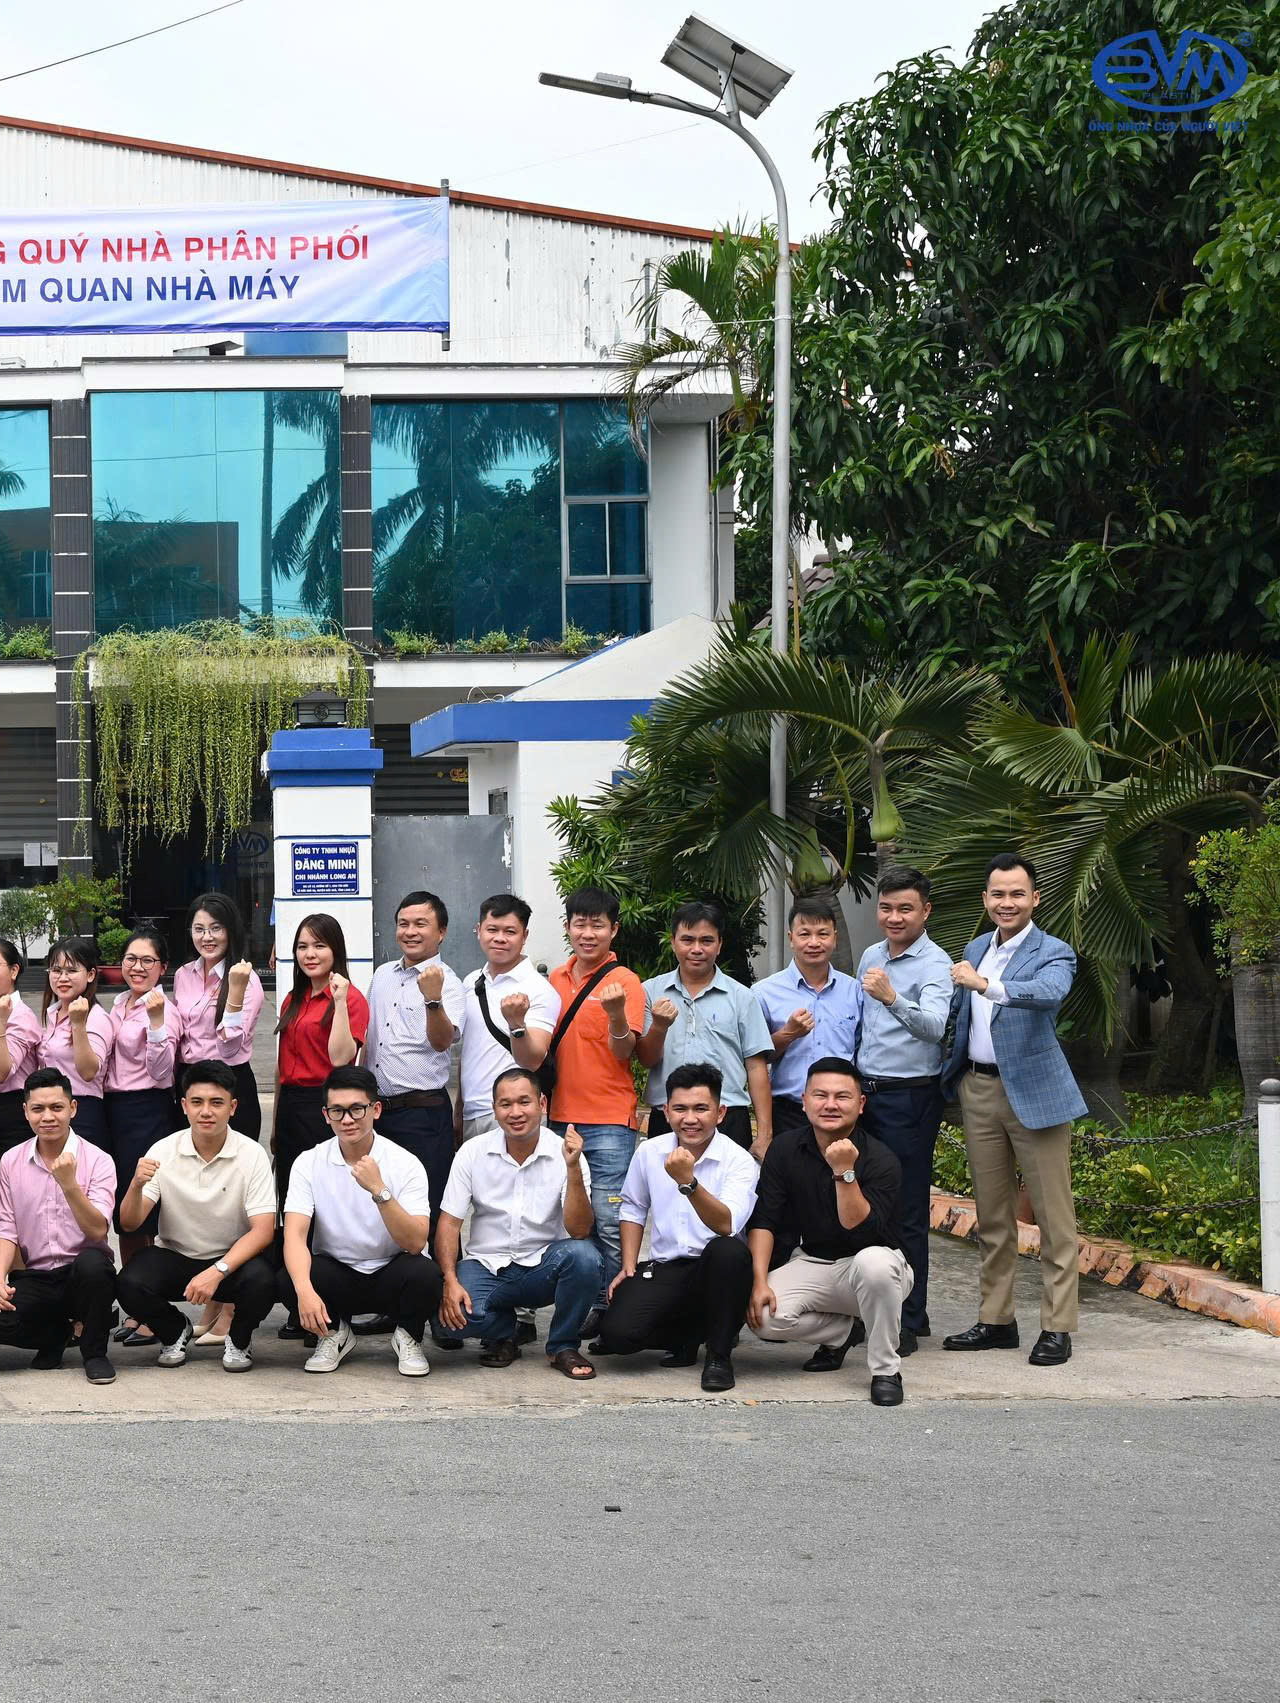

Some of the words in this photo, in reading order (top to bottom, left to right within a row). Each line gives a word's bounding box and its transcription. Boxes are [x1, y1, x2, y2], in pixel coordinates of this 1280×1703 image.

[18, 232, 89, 265] QUÝ
[102, 230, 173, 263] NHÀ
[184, 229, 276, 261] PHÂN
[290, 225, 369, 260] PHỐI
[39, 277, 133, 303] QUAN
[146, 268, 217, 301] NHÀ
[228, 268, 300, 300] MÁY
[328, 859, 356, 870] MINH
